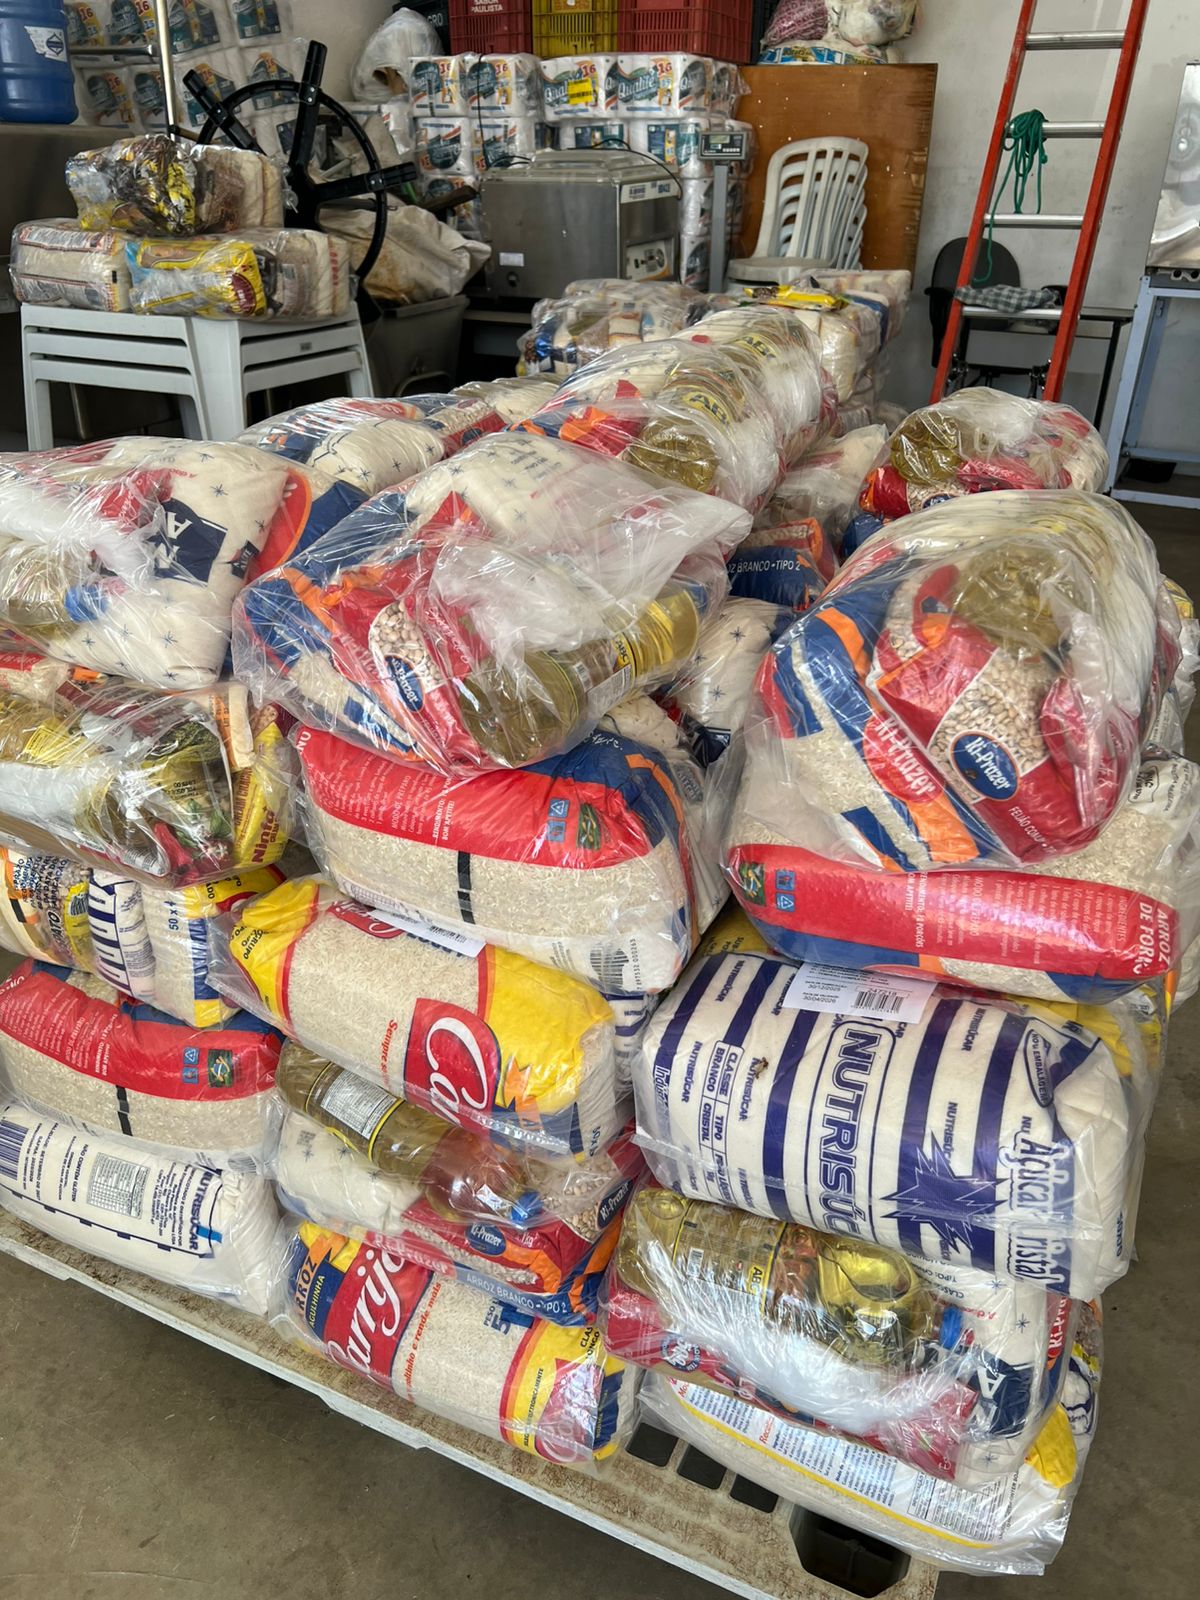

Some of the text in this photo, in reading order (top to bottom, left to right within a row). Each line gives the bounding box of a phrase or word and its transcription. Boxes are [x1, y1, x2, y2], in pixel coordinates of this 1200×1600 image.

[617, 68, 656, 98] Qualité
[658, 62, 672, 75] 16
[737, 560, 770, 573] BRANCO
[776, 560, 794, 571] TIPO
[614, 641, 629, 663] ABC
[963, 737, 1011, 791] Ki-Prazer
[250, 807, 276, 864] Ninfa
[1008, 806, 1030, 830] FEIJÃO
[43, 870, 52, 891] DATA
[904, 884, 914, 910] APETITE!
[973, 876, 983, 896] MODO
[167, 918, 179, 930] 50
[1115, 895, 1129, 942] INGREDIENTES
[1139, 902, 1153, 921] DE
[914, 922, 925, 947] PORÇÕES
[1156, 908, 1172, 964] ARROZ
[716, 960, 745, 1002] NUTRISÚCAR
[378, 1018, 398, 1062] Sempre
[962, 1008, 985, 1051] NUTRISÚCAR
[681, 1041, 703, 1103] NUTRISÚCAR
[706, 1047, 726, 1093] BRANCO
[717, 1052, 739, 1098] CLASSE
[1032, 1049, 1051, 1105] EMBALAGEM
[701, 1102, 713, 1143] CRISTAL
[714, 1114, 724, 1142] TIPO
[819, 1029, 881, 1236] NUTRISÚC
[944, 1101, 958, 1161] NUTRISÚ
[34, 1150, 46, 1180] SETEMBRO
[35, 1180, 40, 1188] DE
[69, 1143, 88, 1202] NÃO CONTÉM GLÚTEN
[1002, 1137, 1068, 1212] Açúcar
[189, 1170, 215, 1250] NUTRISÚCAR
[601, 1180, 629, 1221] Ki-Prazer
[468, 1222, 503, 1247] Ki-Prazer
[521, 1234, 535, 1248] 1kg
[295, 1259, 318, 1317] RROZ
[308, 1275, 326, 1328] AGULHINHA
[466, 1274, 495, 1295] ARROZ
[496, 1283, 535, 1310] BRANCO
[561, 1301, 568, 1313] 2
[412, 1308, 432, 1342] rende
[425, 1279, 443, 1308] mais
[482, 1304, 496, 1327] PESO
[579, 1324, 594, 1348] CLAS
[585, 1329, 600, 1358] ONGO
